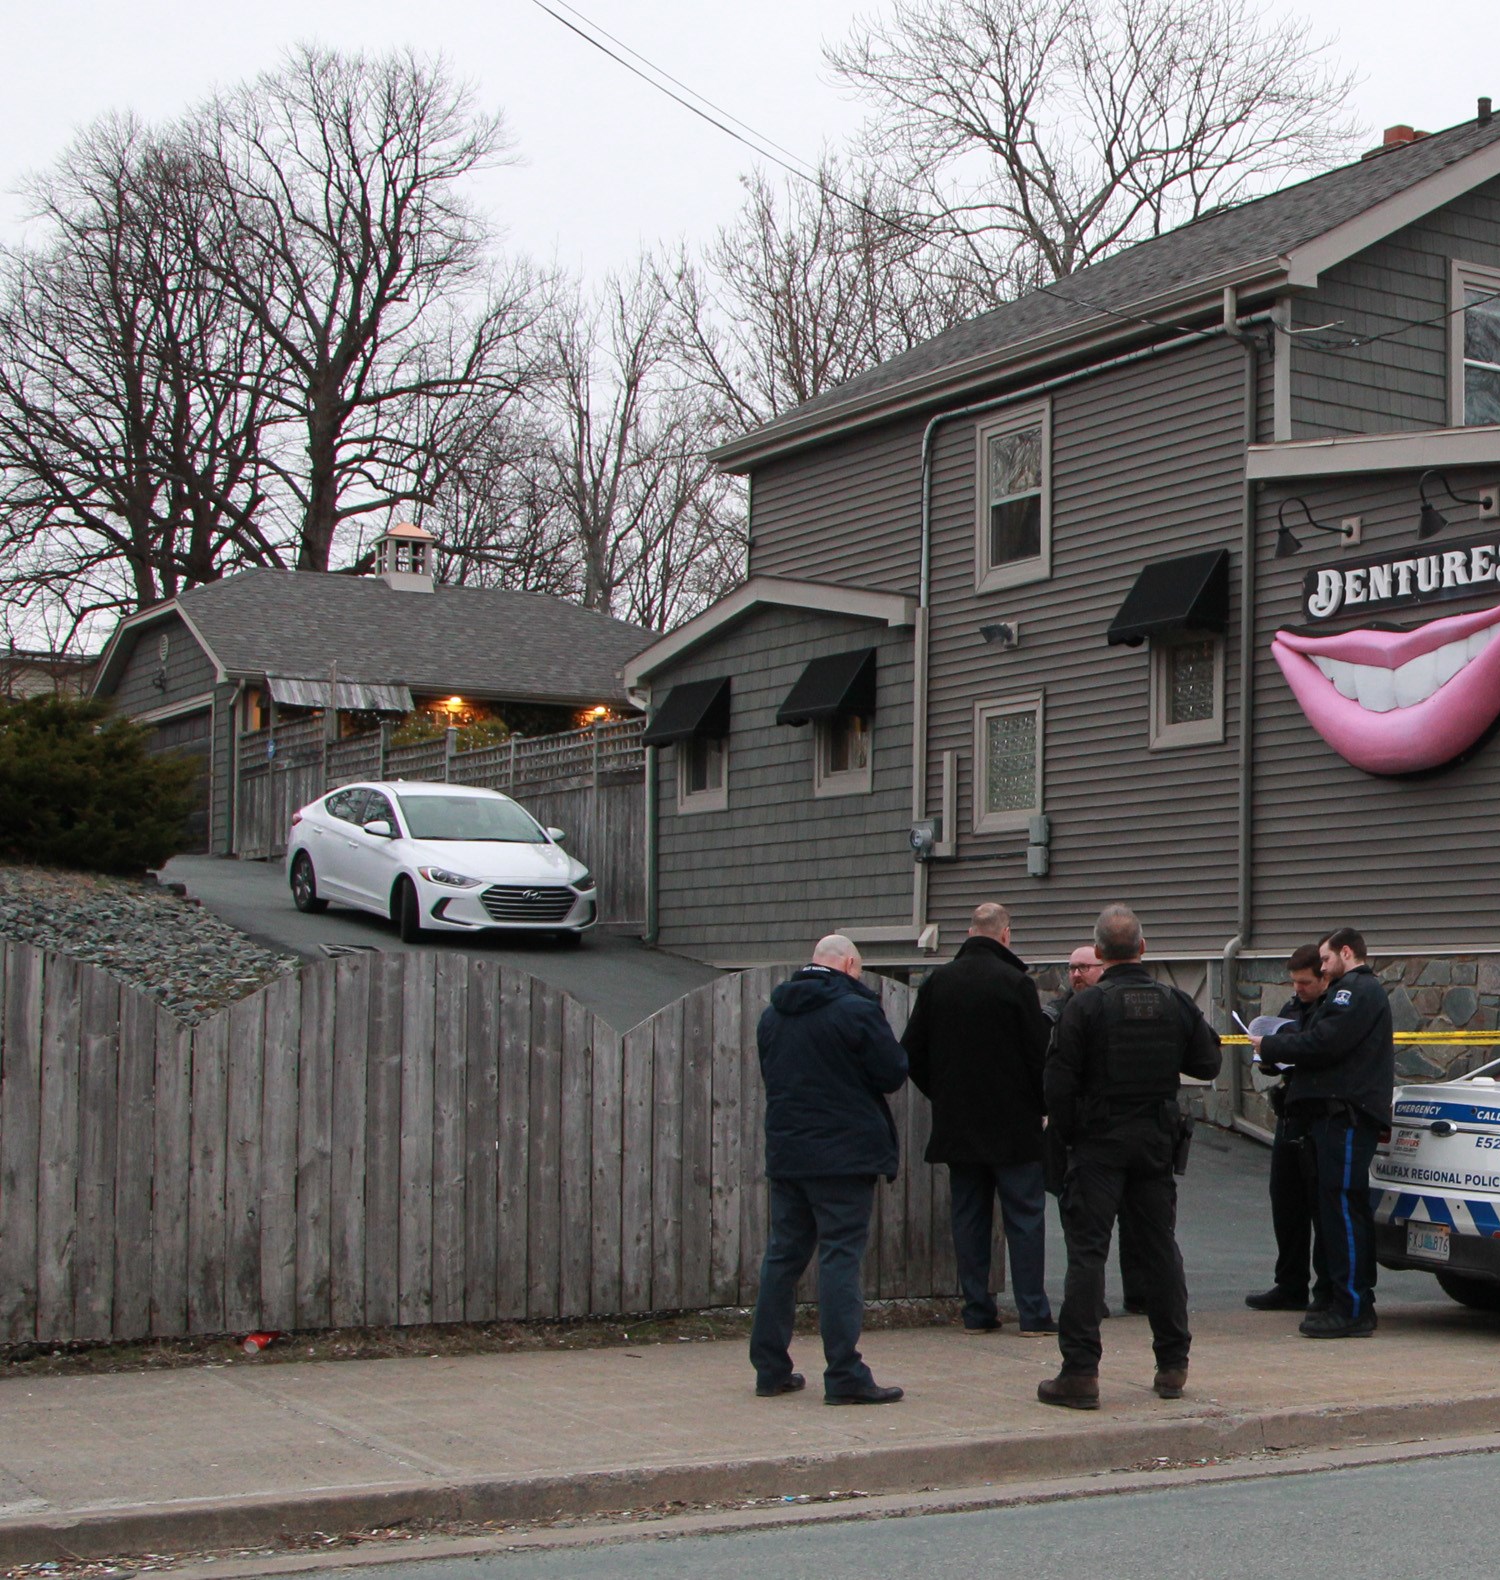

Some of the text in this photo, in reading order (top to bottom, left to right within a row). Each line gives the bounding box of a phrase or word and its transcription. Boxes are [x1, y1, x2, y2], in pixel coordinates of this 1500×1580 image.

[1124, 993, 1160, 1004] POLICE
[1396, 1104, 1442, 1116] EMERGENCY
[1376, 1163, 1410, 1178] HALIFAX
[1411, 1167, 1462, 1185] REGIONAL
